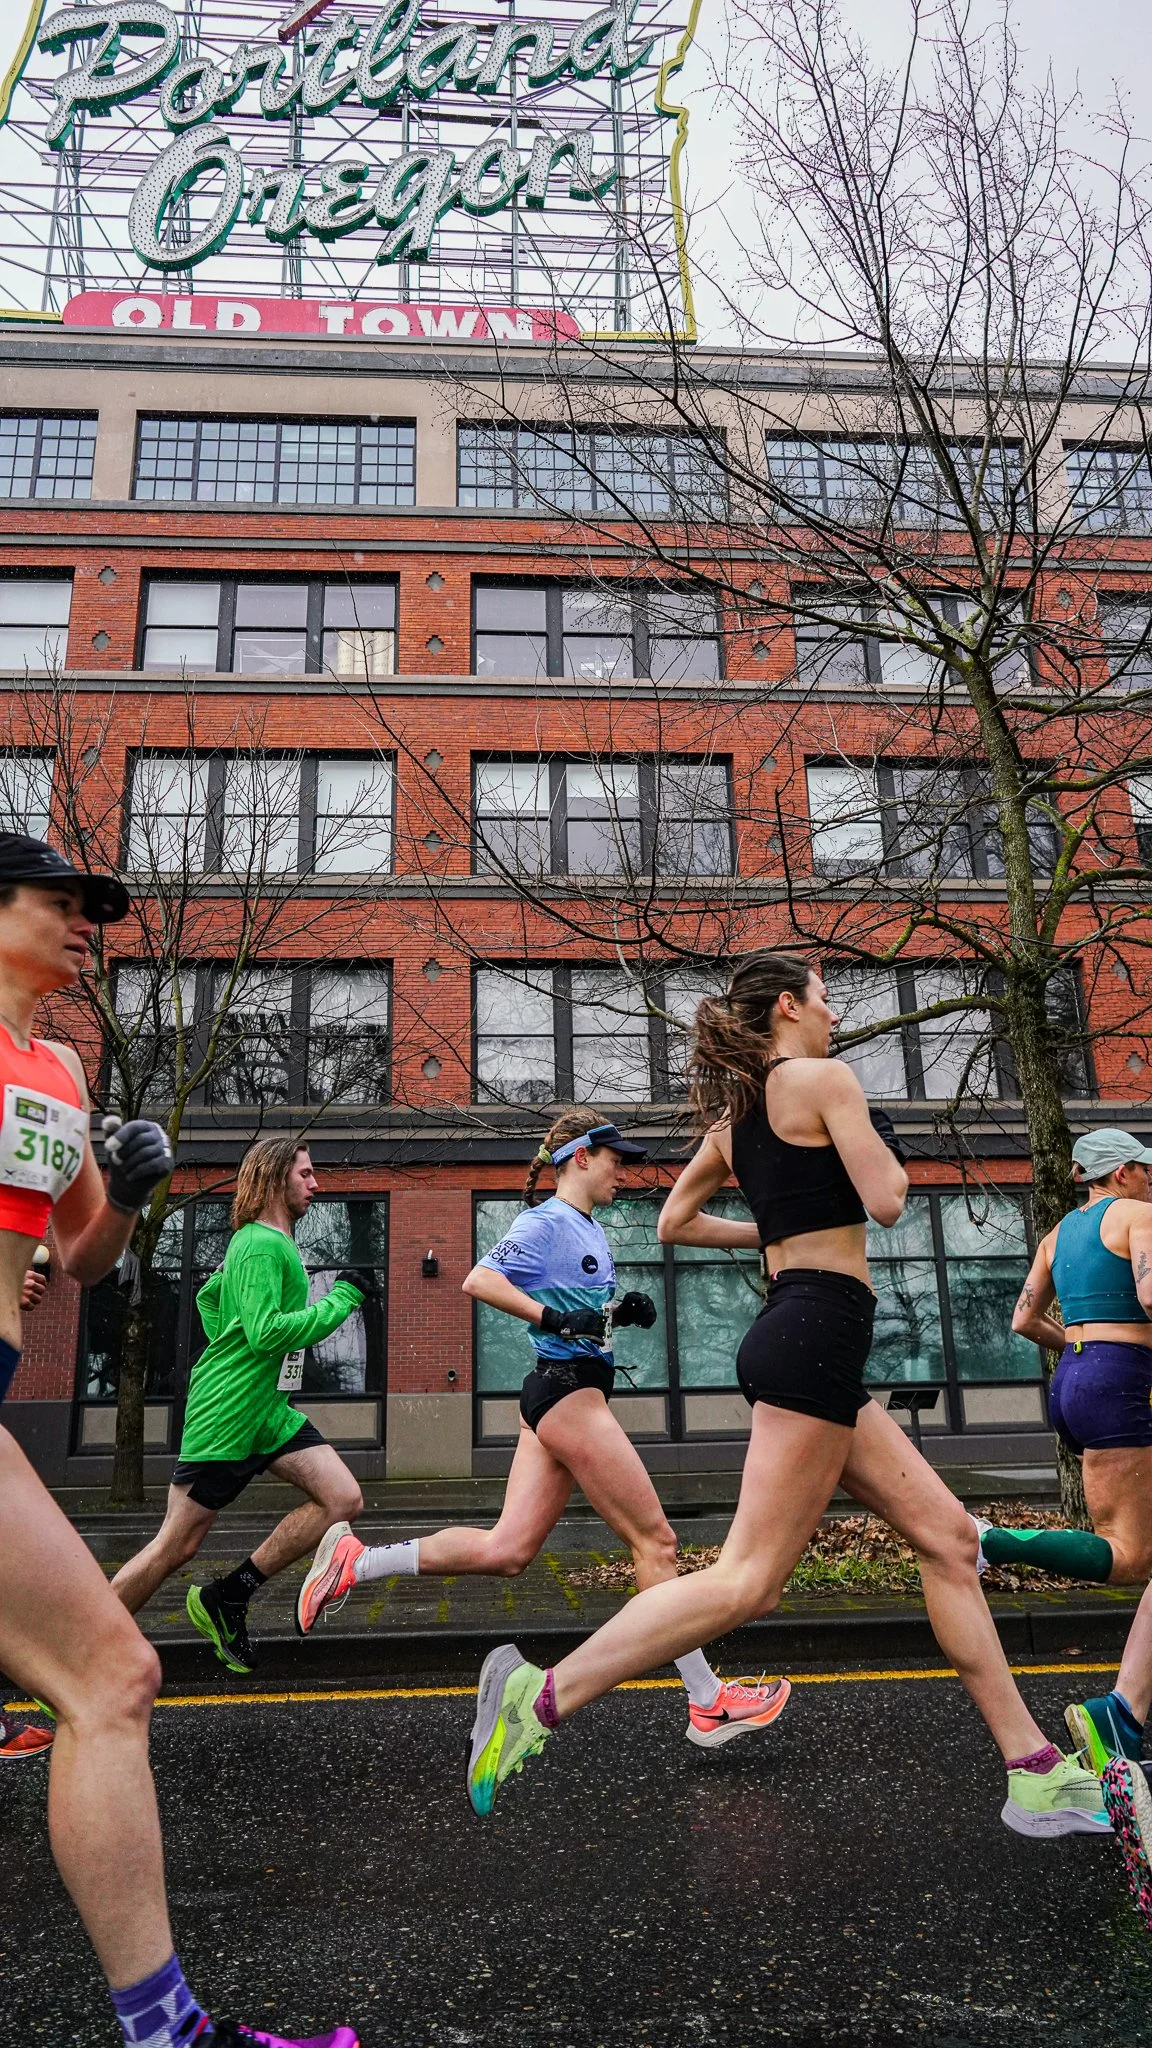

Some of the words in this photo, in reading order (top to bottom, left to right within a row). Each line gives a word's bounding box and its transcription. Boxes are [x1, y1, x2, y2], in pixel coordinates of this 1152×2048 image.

[37, 0, 655, 150] Portland
[128, 123, 617, 270] Oregon
[111, 296, 262, 332] OLD
[318, 303, 533, 340] TOWN
